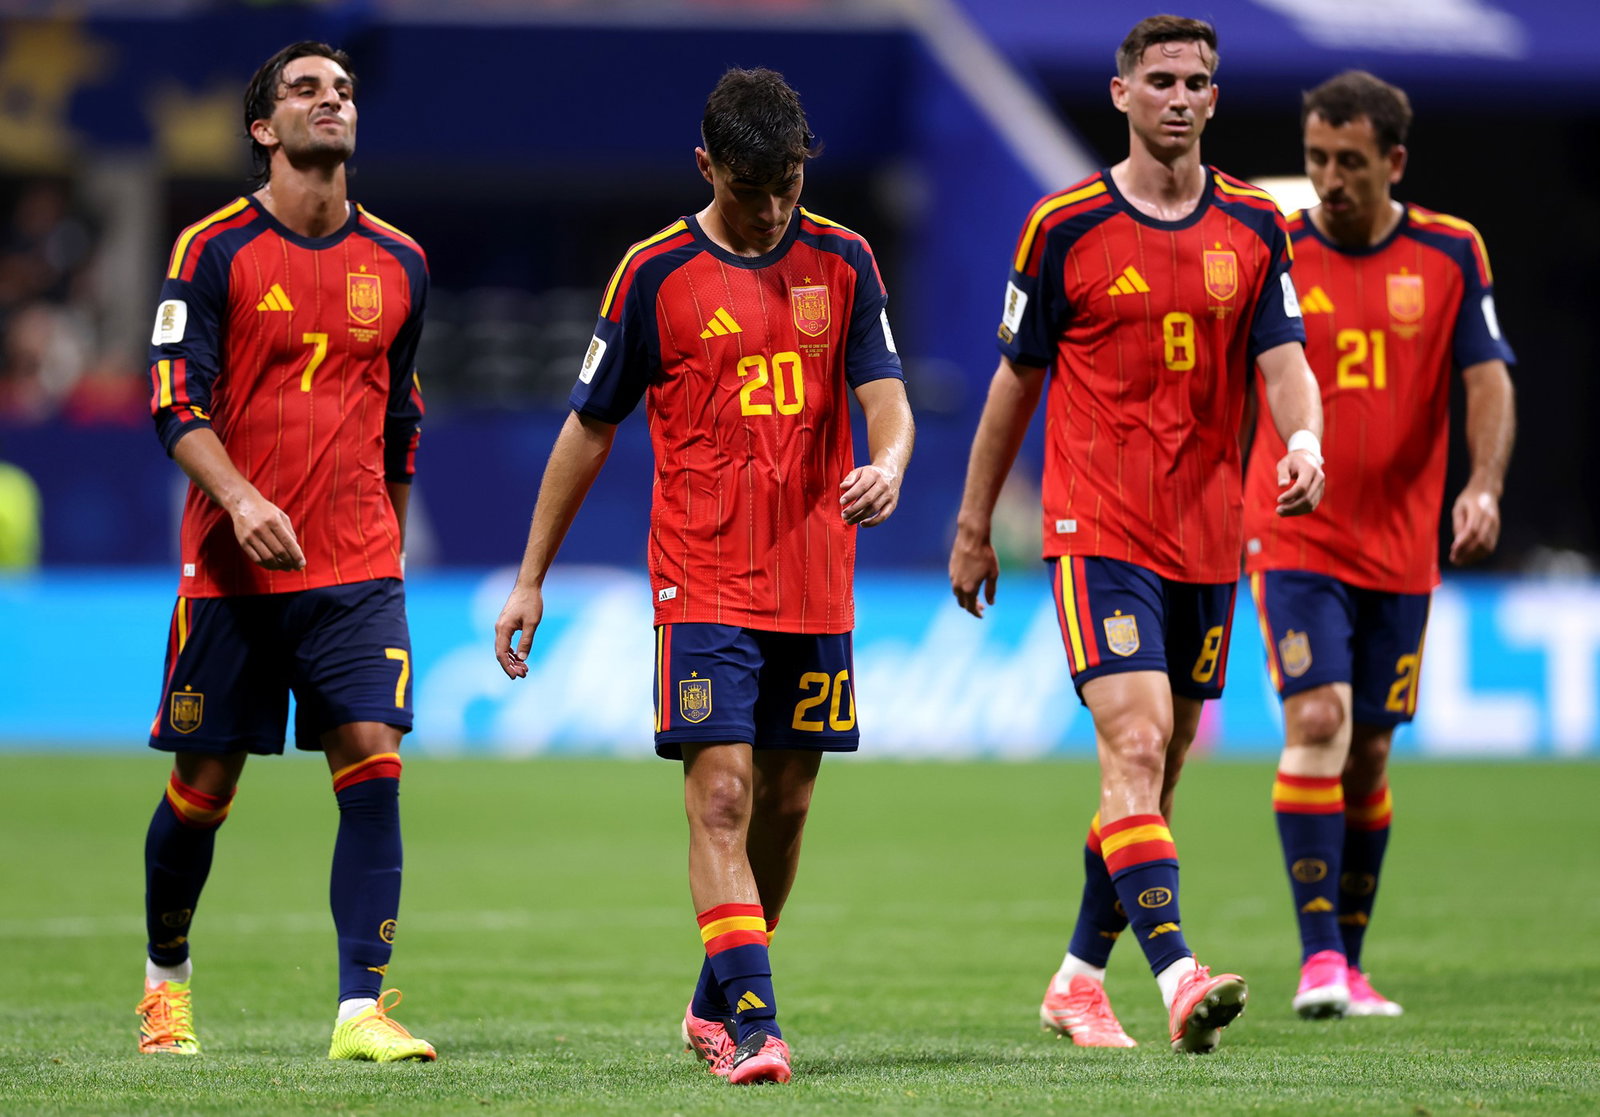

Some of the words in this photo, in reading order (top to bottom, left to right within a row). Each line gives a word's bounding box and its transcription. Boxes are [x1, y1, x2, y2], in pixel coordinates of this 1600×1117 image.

[301, 333, 328, 392] 7
[1163, 312, 1195, 371] 8
[1336, 330, 1386, 389] 21
[737, 351, 805, 416] 20
[385, 648, 410, 708] 7
[1193, 625, 1224, 684] 8
[791, 669, 856, 732] 20
